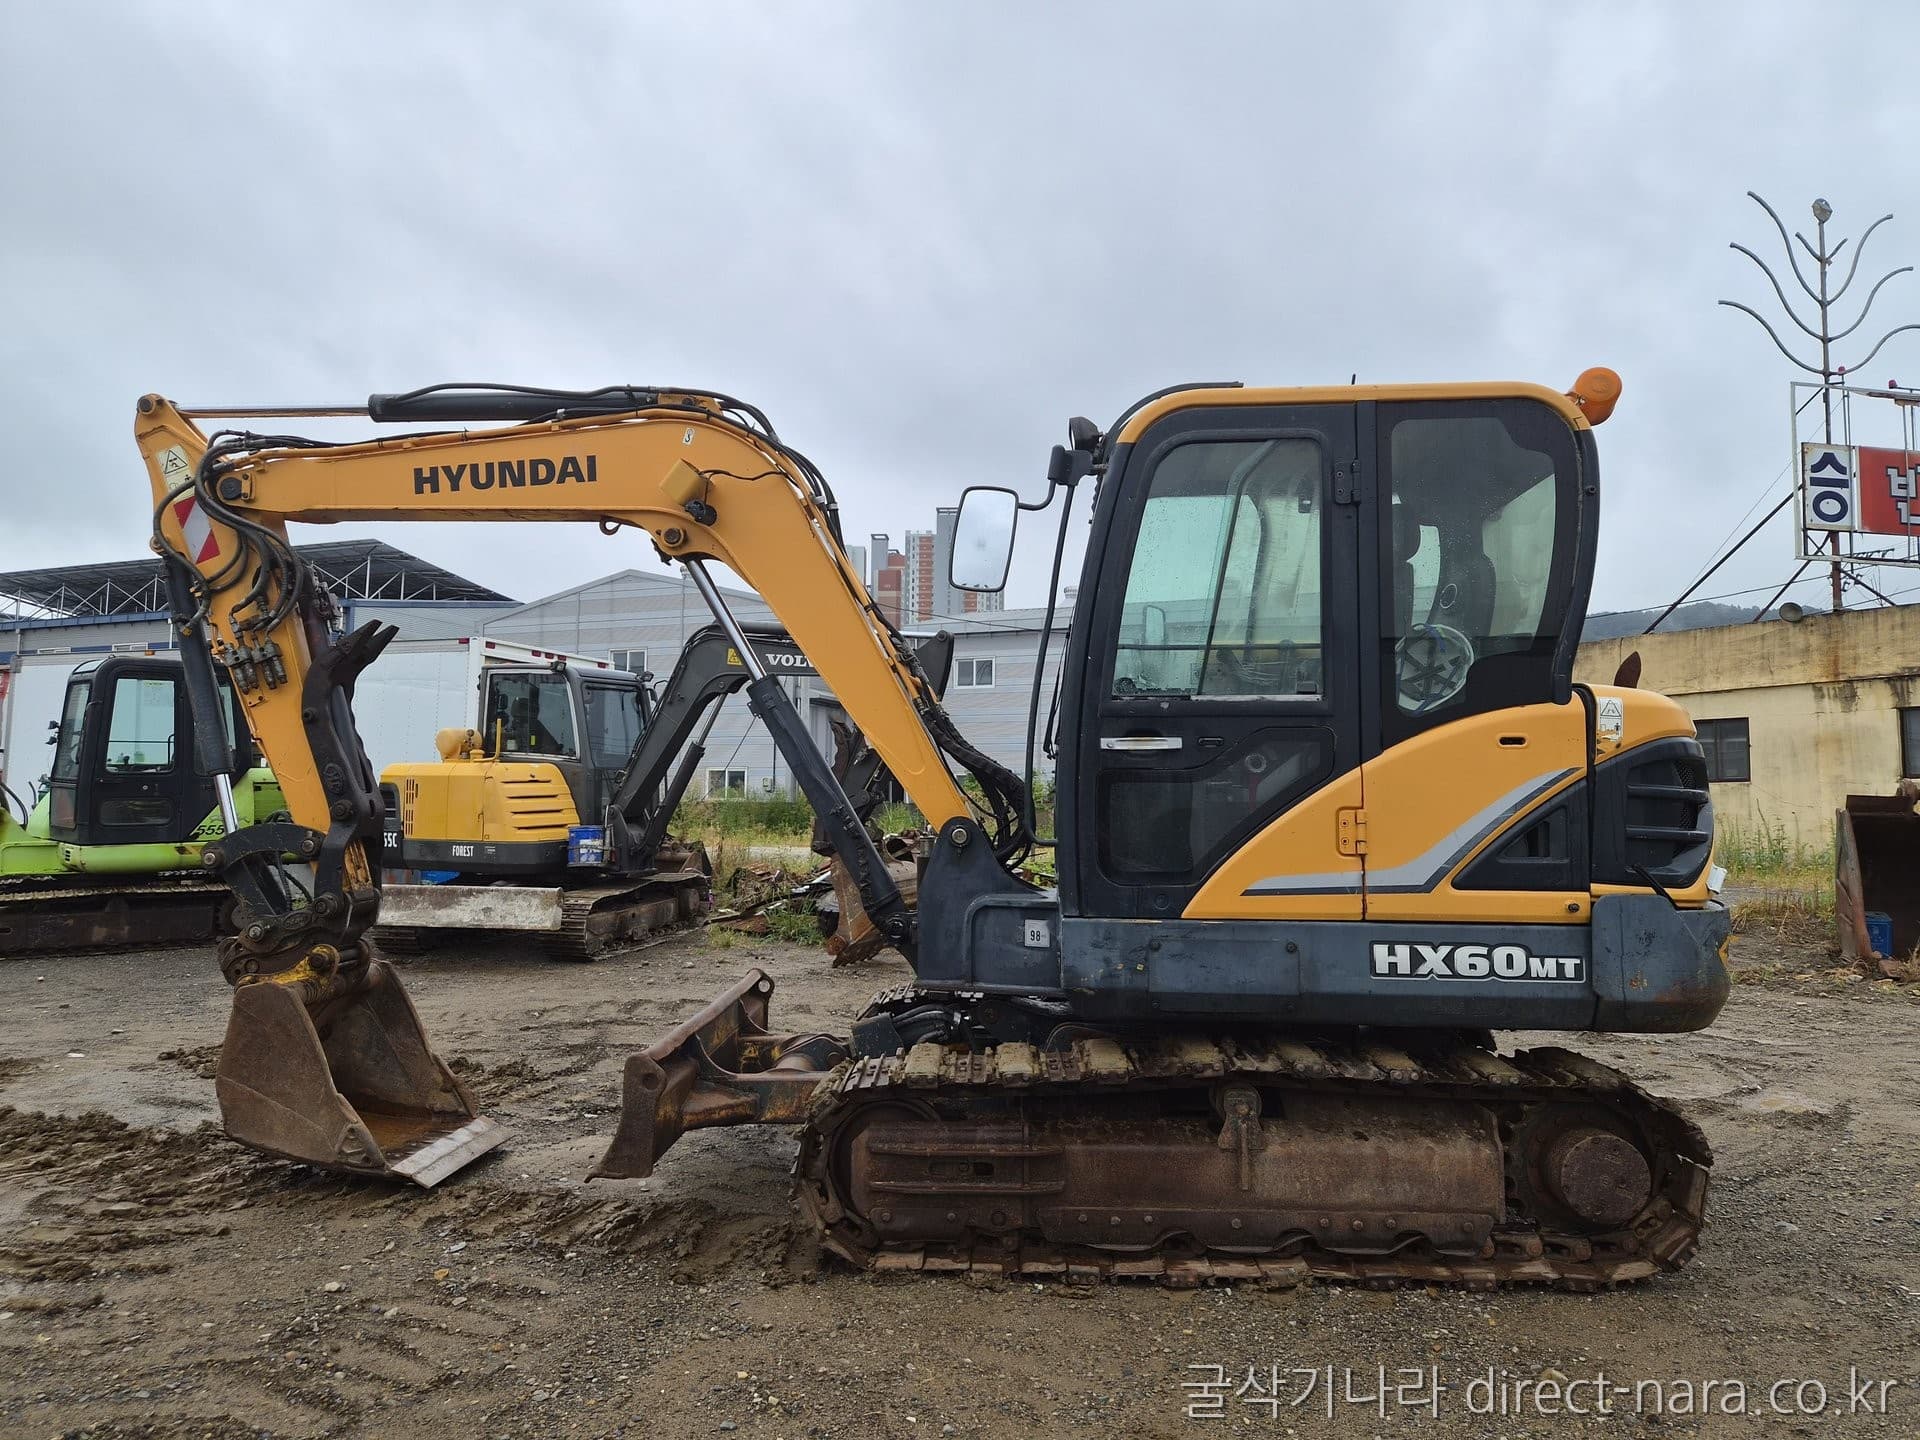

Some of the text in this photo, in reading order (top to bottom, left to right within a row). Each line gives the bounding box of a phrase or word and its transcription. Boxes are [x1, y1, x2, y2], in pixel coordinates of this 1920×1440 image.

[413, 455, 597, 495] HYUNDAI
[1810, 452, 1850, 523] 승
[452, 845, 474, 857] FOREST
[1030, 930, 1041, 941] 98
